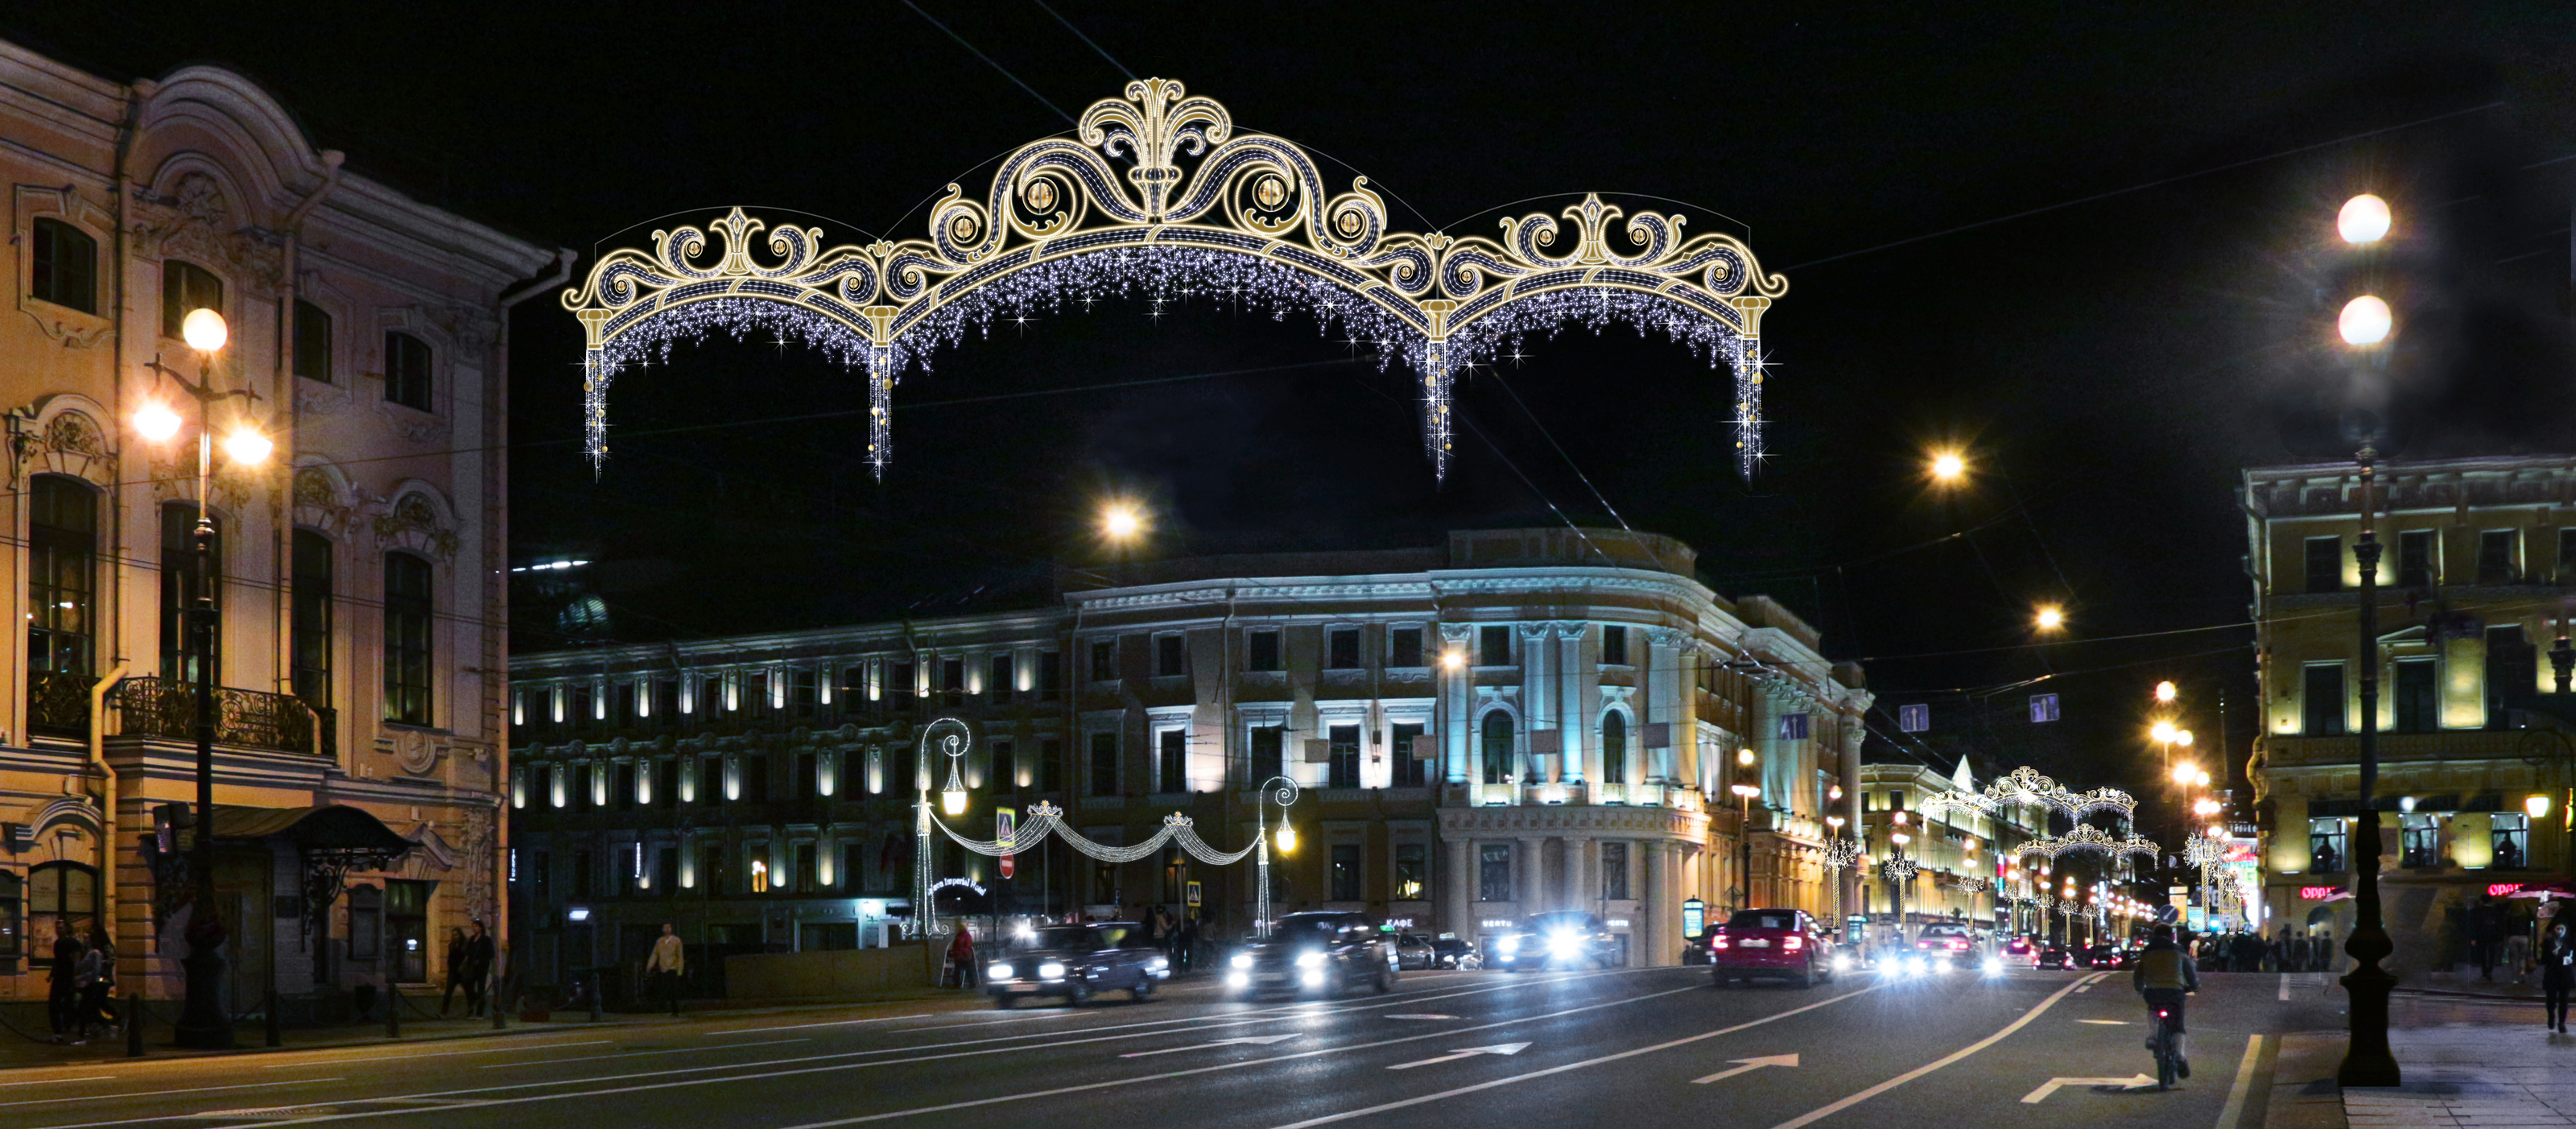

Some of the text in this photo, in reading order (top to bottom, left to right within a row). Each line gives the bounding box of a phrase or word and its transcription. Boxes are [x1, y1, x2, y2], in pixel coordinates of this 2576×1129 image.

[970, 880, 987, 895] Hotel
[1386, 919, 1413, 928] КАФЕ
[1482, 920, 1512, 928] VERTU
